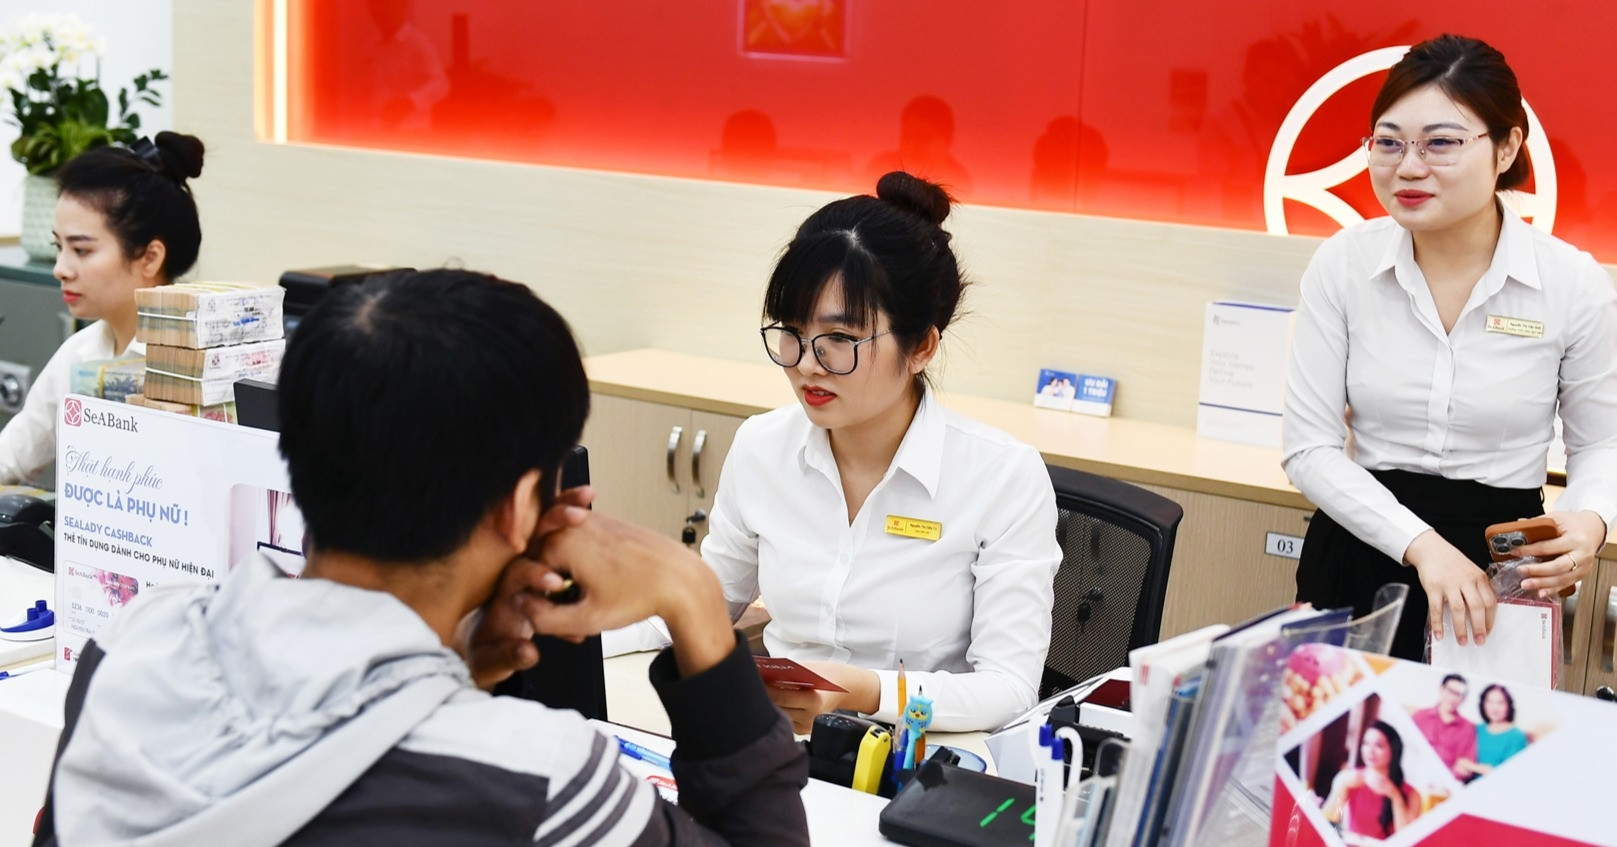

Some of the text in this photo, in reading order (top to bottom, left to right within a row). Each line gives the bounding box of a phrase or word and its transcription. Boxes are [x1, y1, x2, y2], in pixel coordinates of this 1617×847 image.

[83, 407, 139, 433] SeABank
[65, 449, 164, 495] Thật hạnh phúc
[64, 482, 104, 508] ĐƯỢC
[106, 489, 124, 511] LÀ
[127, 496, 156, 523] PHỤ
[159, 503, 182, 525] NỮ
[64, 515, 153, 548] SEALADY CASHBACK
[1277, 538, 1294, 554] 03
[63, 532, 214, 580] THẺ TÍN DỤNG DÀNH CHO PHỤ NỮ HIỆN ĐẠI
